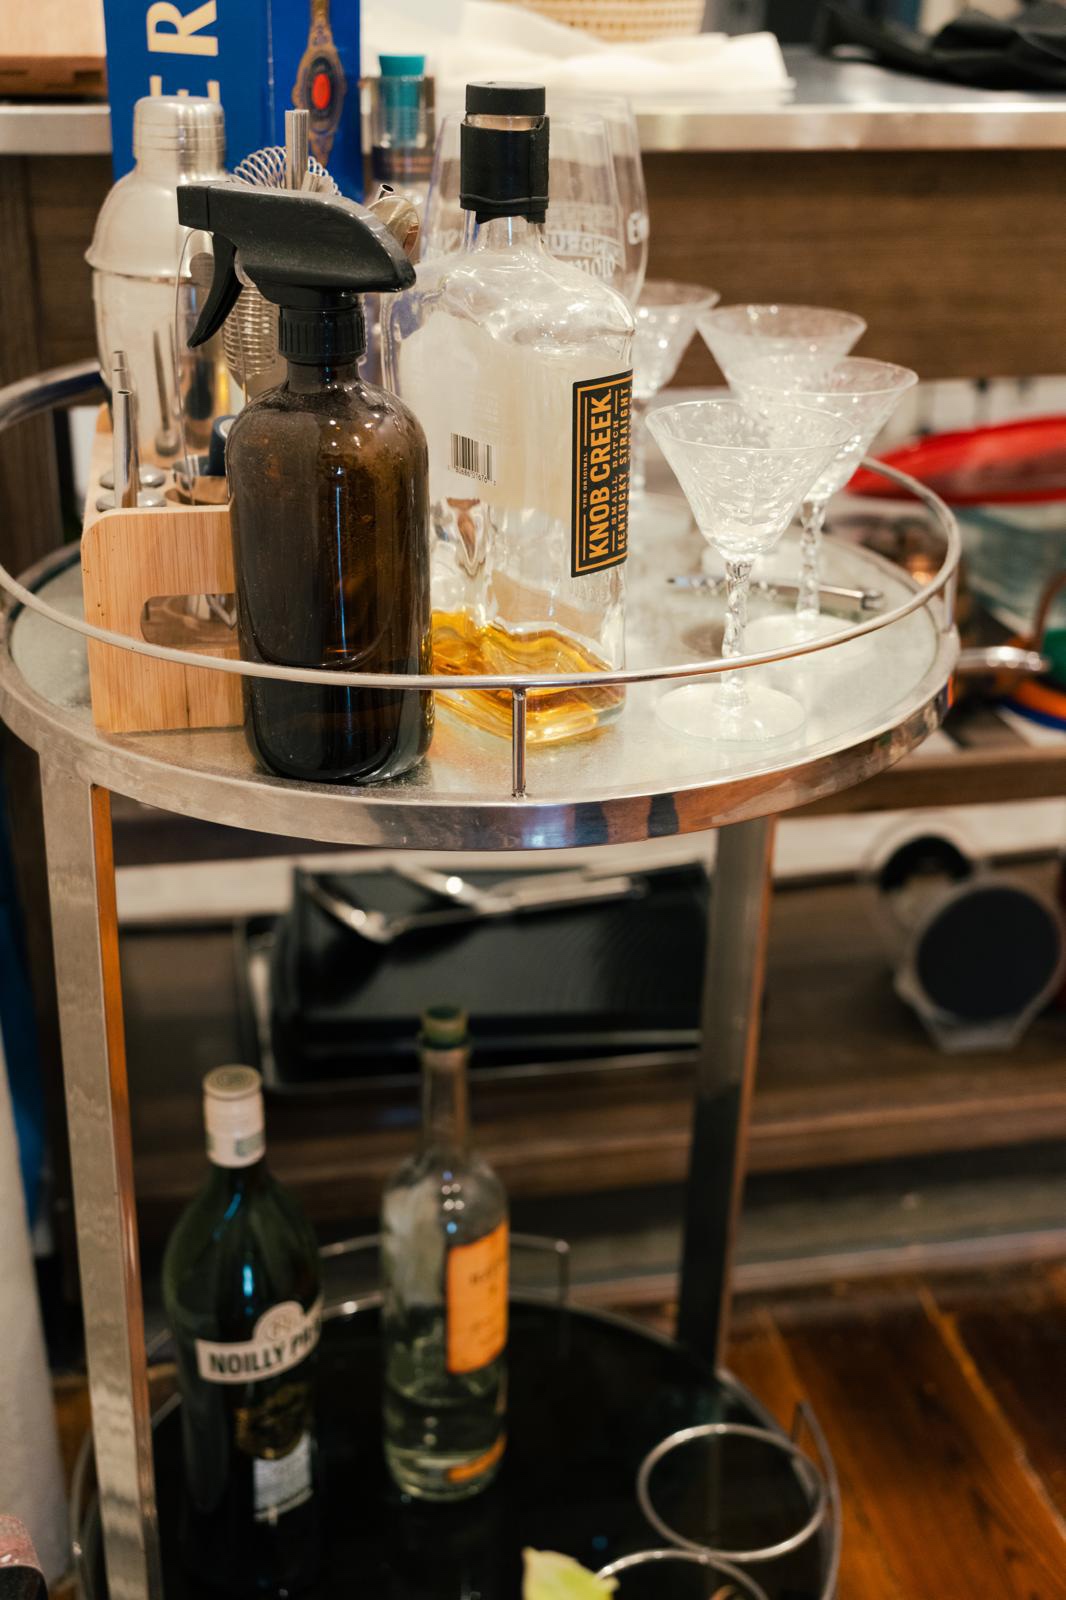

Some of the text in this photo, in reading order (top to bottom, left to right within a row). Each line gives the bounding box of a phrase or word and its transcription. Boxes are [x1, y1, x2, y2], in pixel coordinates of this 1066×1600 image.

[619, 385, 630, 465] STRAIGHT
[589, 486, 611, 559] KNOB
[617, 472, 628, 550] KENTUCKY
[209, 1341, 286, 1375] NOILLY
